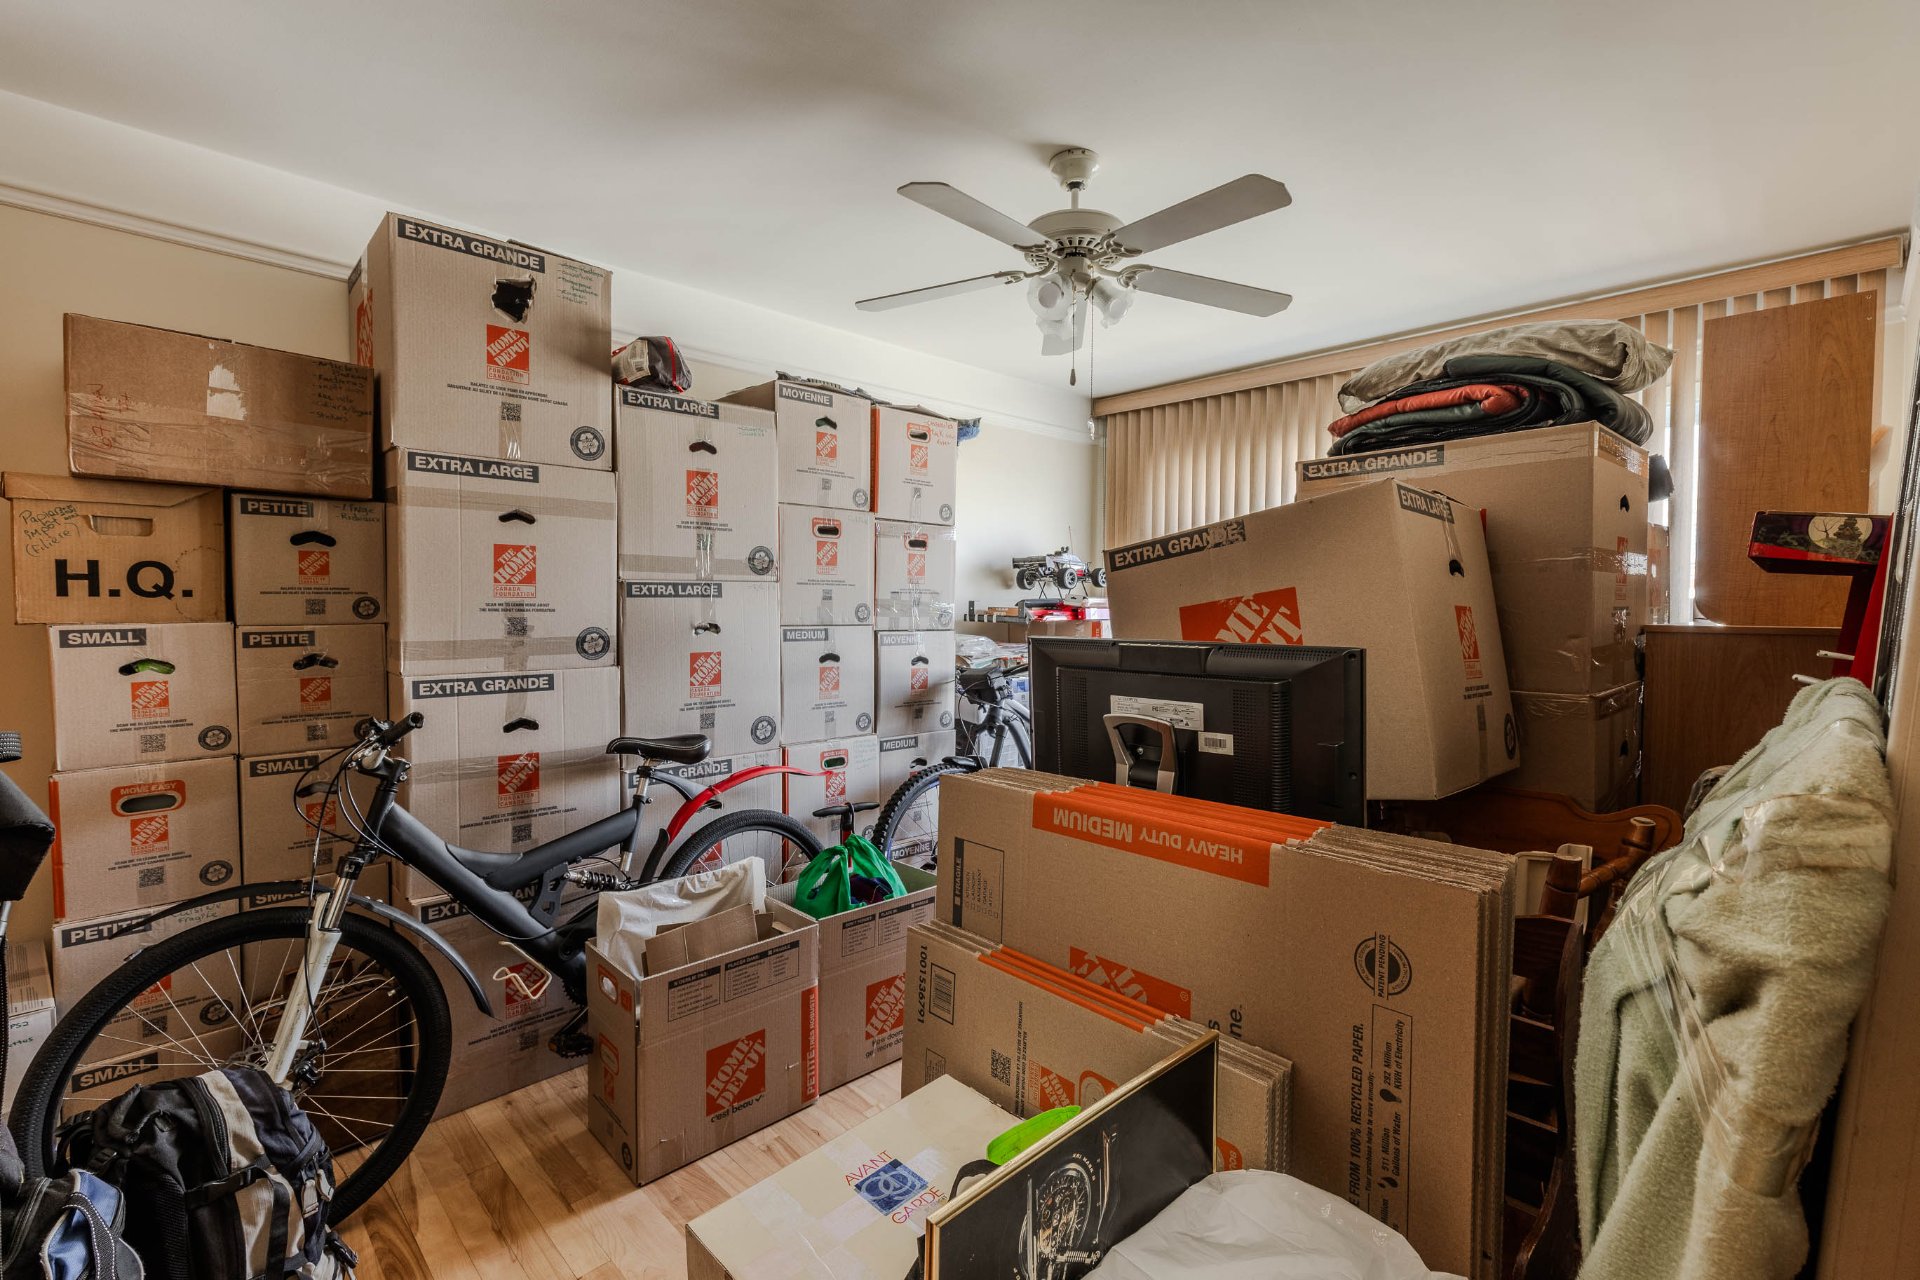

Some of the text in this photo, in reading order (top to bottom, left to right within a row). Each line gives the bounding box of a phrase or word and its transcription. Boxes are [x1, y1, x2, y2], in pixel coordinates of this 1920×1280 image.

[405, 223, 540, 270] EXTRA GRANDE
[487, 329, 520, 358] HOME
[494, 336, 529, 367] DEPOT
[628, 394, 715, 416] EXTRA LARGE
[782, 387, 830, 404] MOYENNE
[816, 433, 832, 450] HOME
[820, 438, 837, 458] DEPOT
[415, 456, 534, 480] EXTRA LARGE
[1308, 450, 1438, 478] EXTRA GRANDE
[687, 473, 718, 505] HOME
[690, 474, 702, 488] THE
[248, 501, 308, 515] PETITE
[1400, 489, 1427, 510] EXTRA
[498, 548, 516, 564] THE
[1114, 523, 1244, 567] EXTRA GRANDE
[299, 551, 321, 570] HOME
[304, 555, 329, 575] DEPOT
[494, 545, 536, 584] HOME
[510, 560, 536, 584] DEPOT
[54, 558, 193, 600] H.Q.
[632, 584, 718, 595] EXTRA LARGE
[67, 632, 139, 644] SMALL
[250, 634, 309, 646] PETITE
[786, 631, 826, 640] MEDIUM
[690, 652, 721, 686] HOME
[693, 655, 706, 670] THE
[702, 664, 721, 685] DEPOT
[132, 682, 168, 709] HOME
[301, 678, 325, 697] HOME
[306, 680, 331, 703] DEPOT
[419, 676, 549, 696] EXTRA GRANDE
[883, 738, 916, 750] MEDIUM
[256, 759, 312, 774] SMALL
[498, 754, 531, 786] HOME
[506, 759, 539, 792] DEPOT
[679, 762, 728, 778] GRANDE
[120, 782, 177, 795] MOVE EASY
[132, 816, 168, 845] HOME
[1053, 807, 1243, 864] HEAVY DUTY MEDIUM
[892, 842, 931, 859] MOYENNE
[1377, 934, 1386, 998] PATENT PENDING
[918, 945, 928, 1023] 1001536791
[870, 985, 887, 1010] THE
[706, 1036, 754, 1099] HOME
[1384, 1042, 1392, 1068] Million
[1394, 1020, 1405, 1090] KWH of Electricity
[80, 1059, 145, 1087] SMALL
[716, 1038, 766, 1111] DEPOT
[807, 1050, 815, 1094] PETITE
[1048, 1072, 1070, 1106] HOM
[1367, 1072, 1375, 1101] annually:
[732, 1100, 754, 1115] beau
[1349, 1023, 1364, 1196] FROM 100% RECYCLED PAPER.
[1366, 1127, 1374, 1145] helps
[1381, 1128, 1390, 1154] Million
[1392, 1112, 1402, 1176] Gallons of Water
[842, 1150, 894, 1186] AVANT
[1366, 1147, 1374, 1177] purchase
[892, 1186, 942, 1225] GARDE
